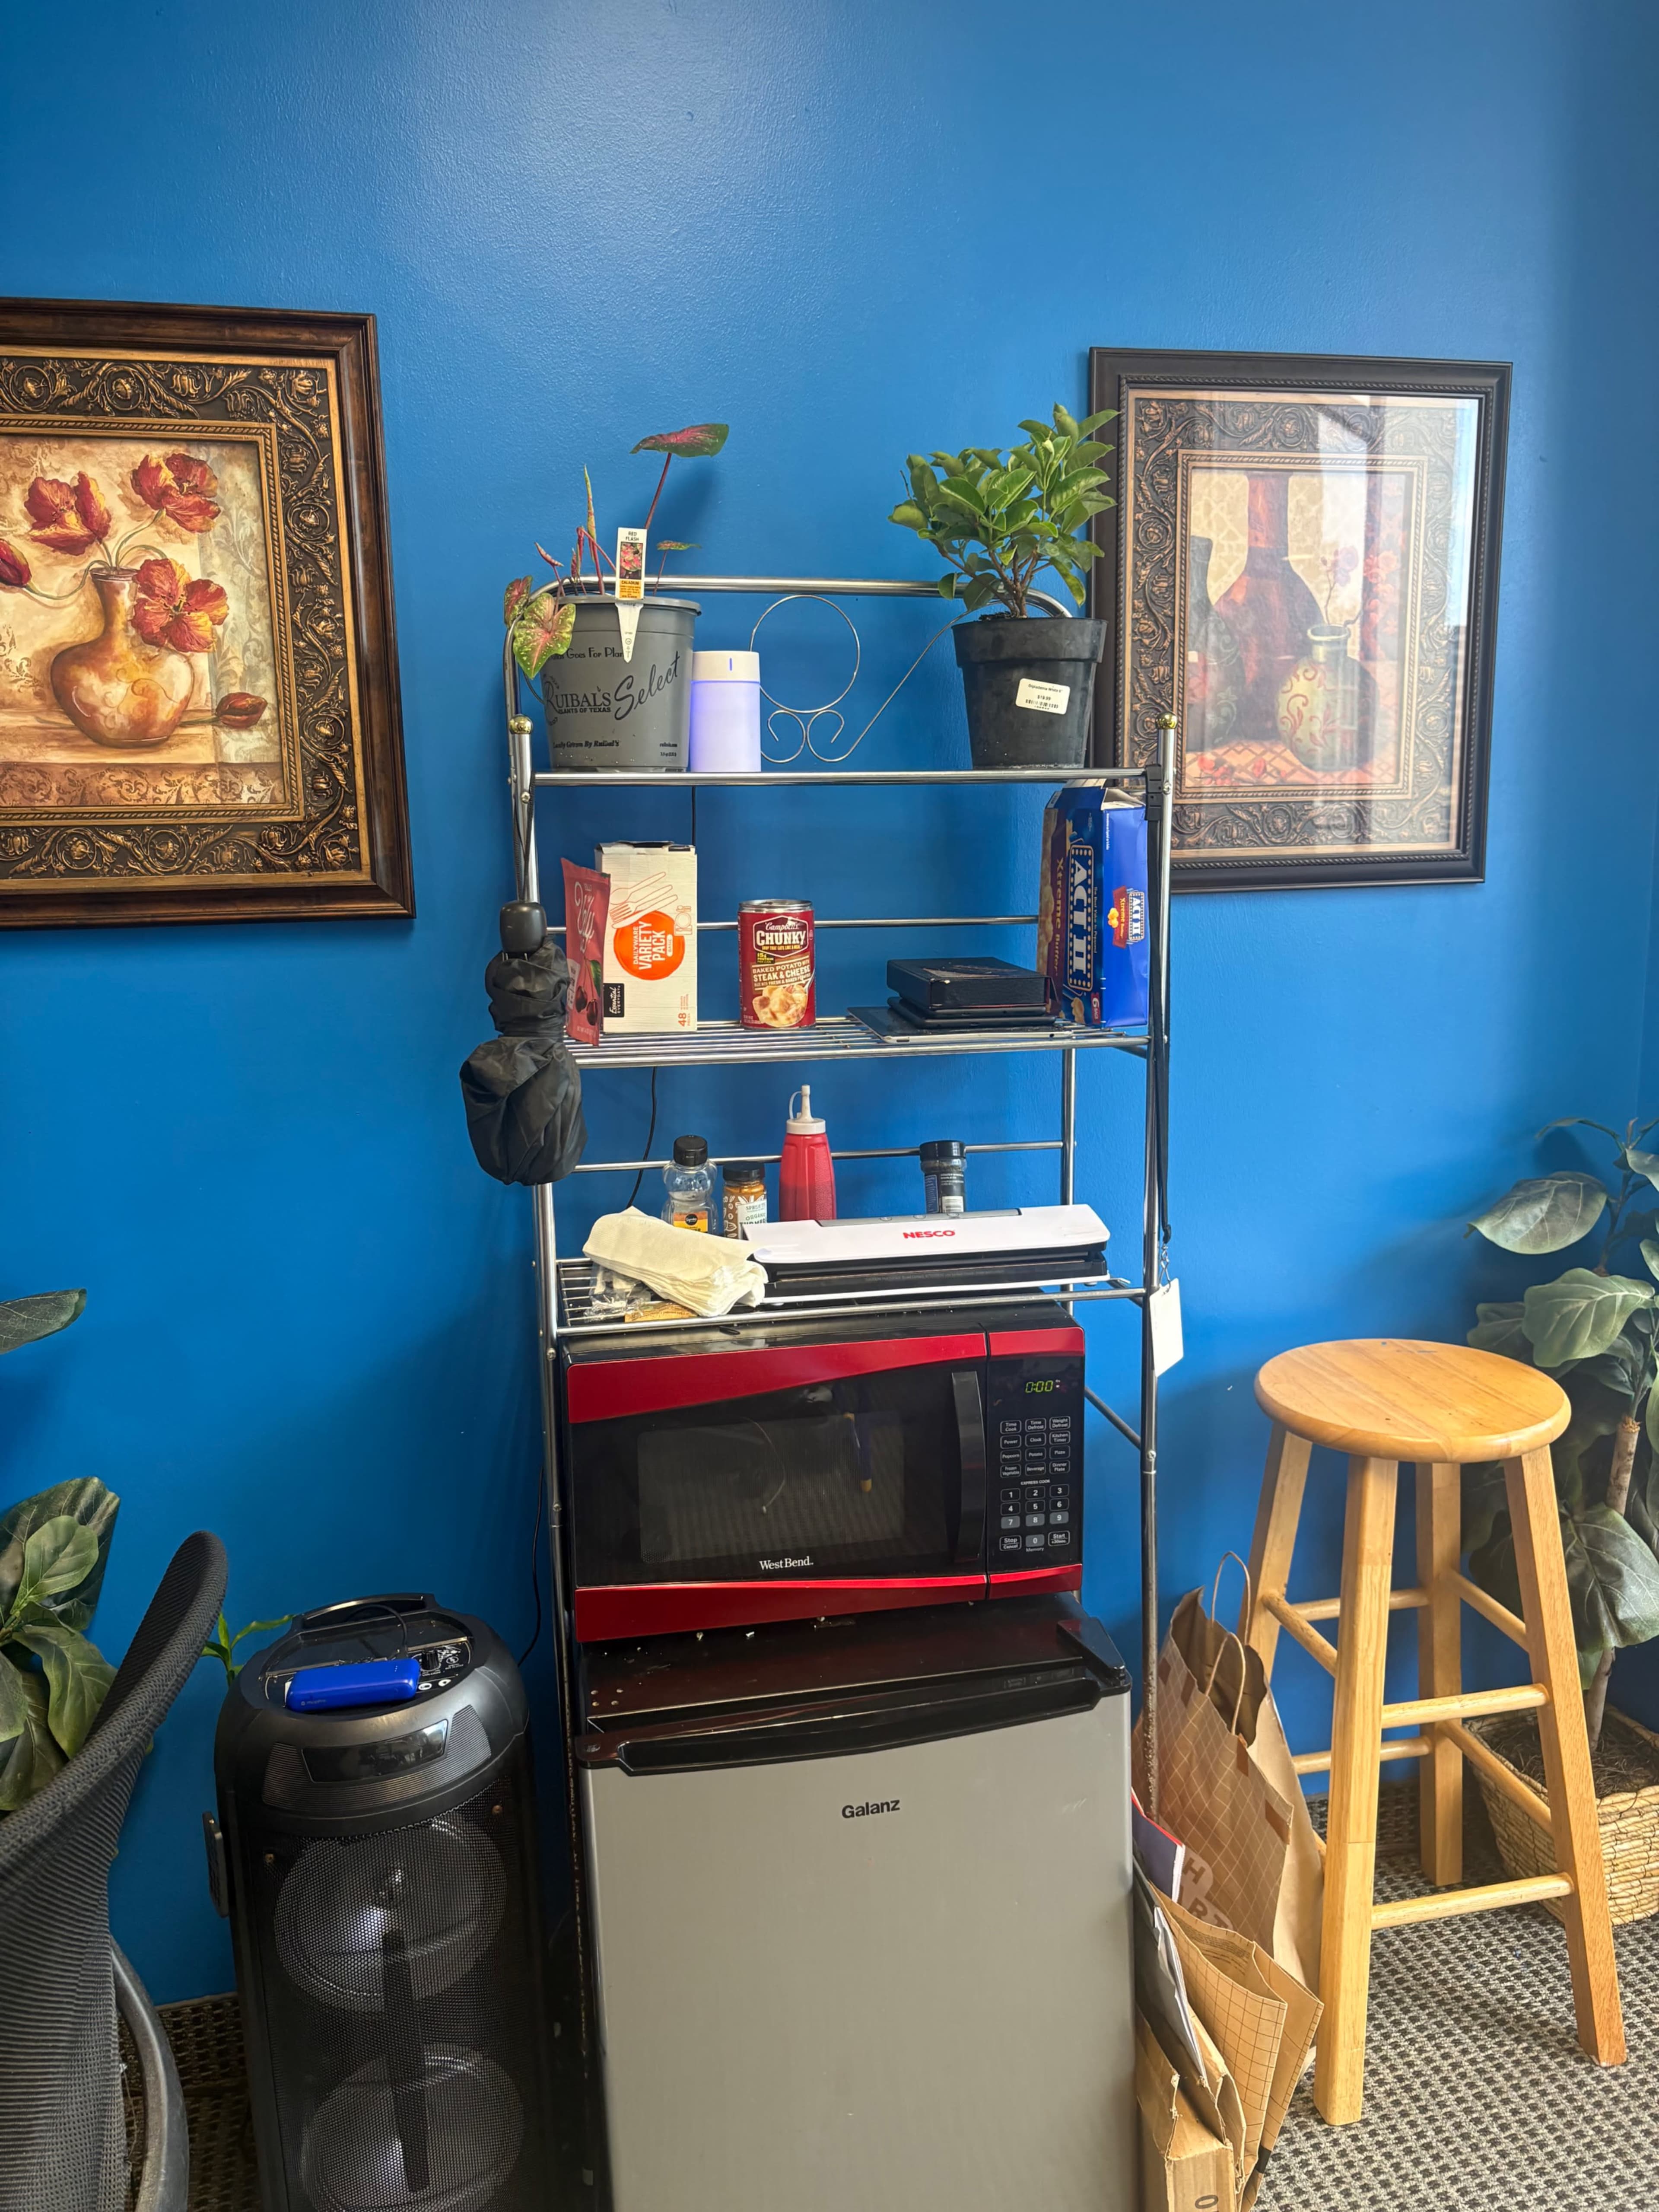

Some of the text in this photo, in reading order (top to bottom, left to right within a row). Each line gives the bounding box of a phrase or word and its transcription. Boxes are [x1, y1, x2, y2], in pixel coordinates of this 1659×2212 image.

[566, 648, 585, 659] Goes
[588, 647, 602, 658] For
[605, 647, 624, 657] Plan
[614, 650, 680, 720] Select
[545, 681, 611, 714] RUIBAL'S
[1073, 860, 1087, 974] ACT II
[1132, 898, 1141, 935] ACT II
[639, 921, 652, 970] VARIETY
[652, 930, 666, 961] PACK
[756, 930, 806, 946] CHUNKY
[753, 972, 778, 982] STEAK
[785, 965, 810, 978] CHEESE
[776, 962, 801, 971] POTATO
[609, 987, 617, 1014] Essential
[1092, 997, 1100, 1008] 6
[678, 1012, 686, 1027] 48
[903, 1230, 955, 1239] NESCO
[1025, 1381, 1053, 1393] 0:00
[759, 1556, 810, 1570] West Bend
[842, 1799, 900, 1818] Galanz
[1183, 1858, 1205, 1885] H
[1177, 1885, 1228, 1929] RT
